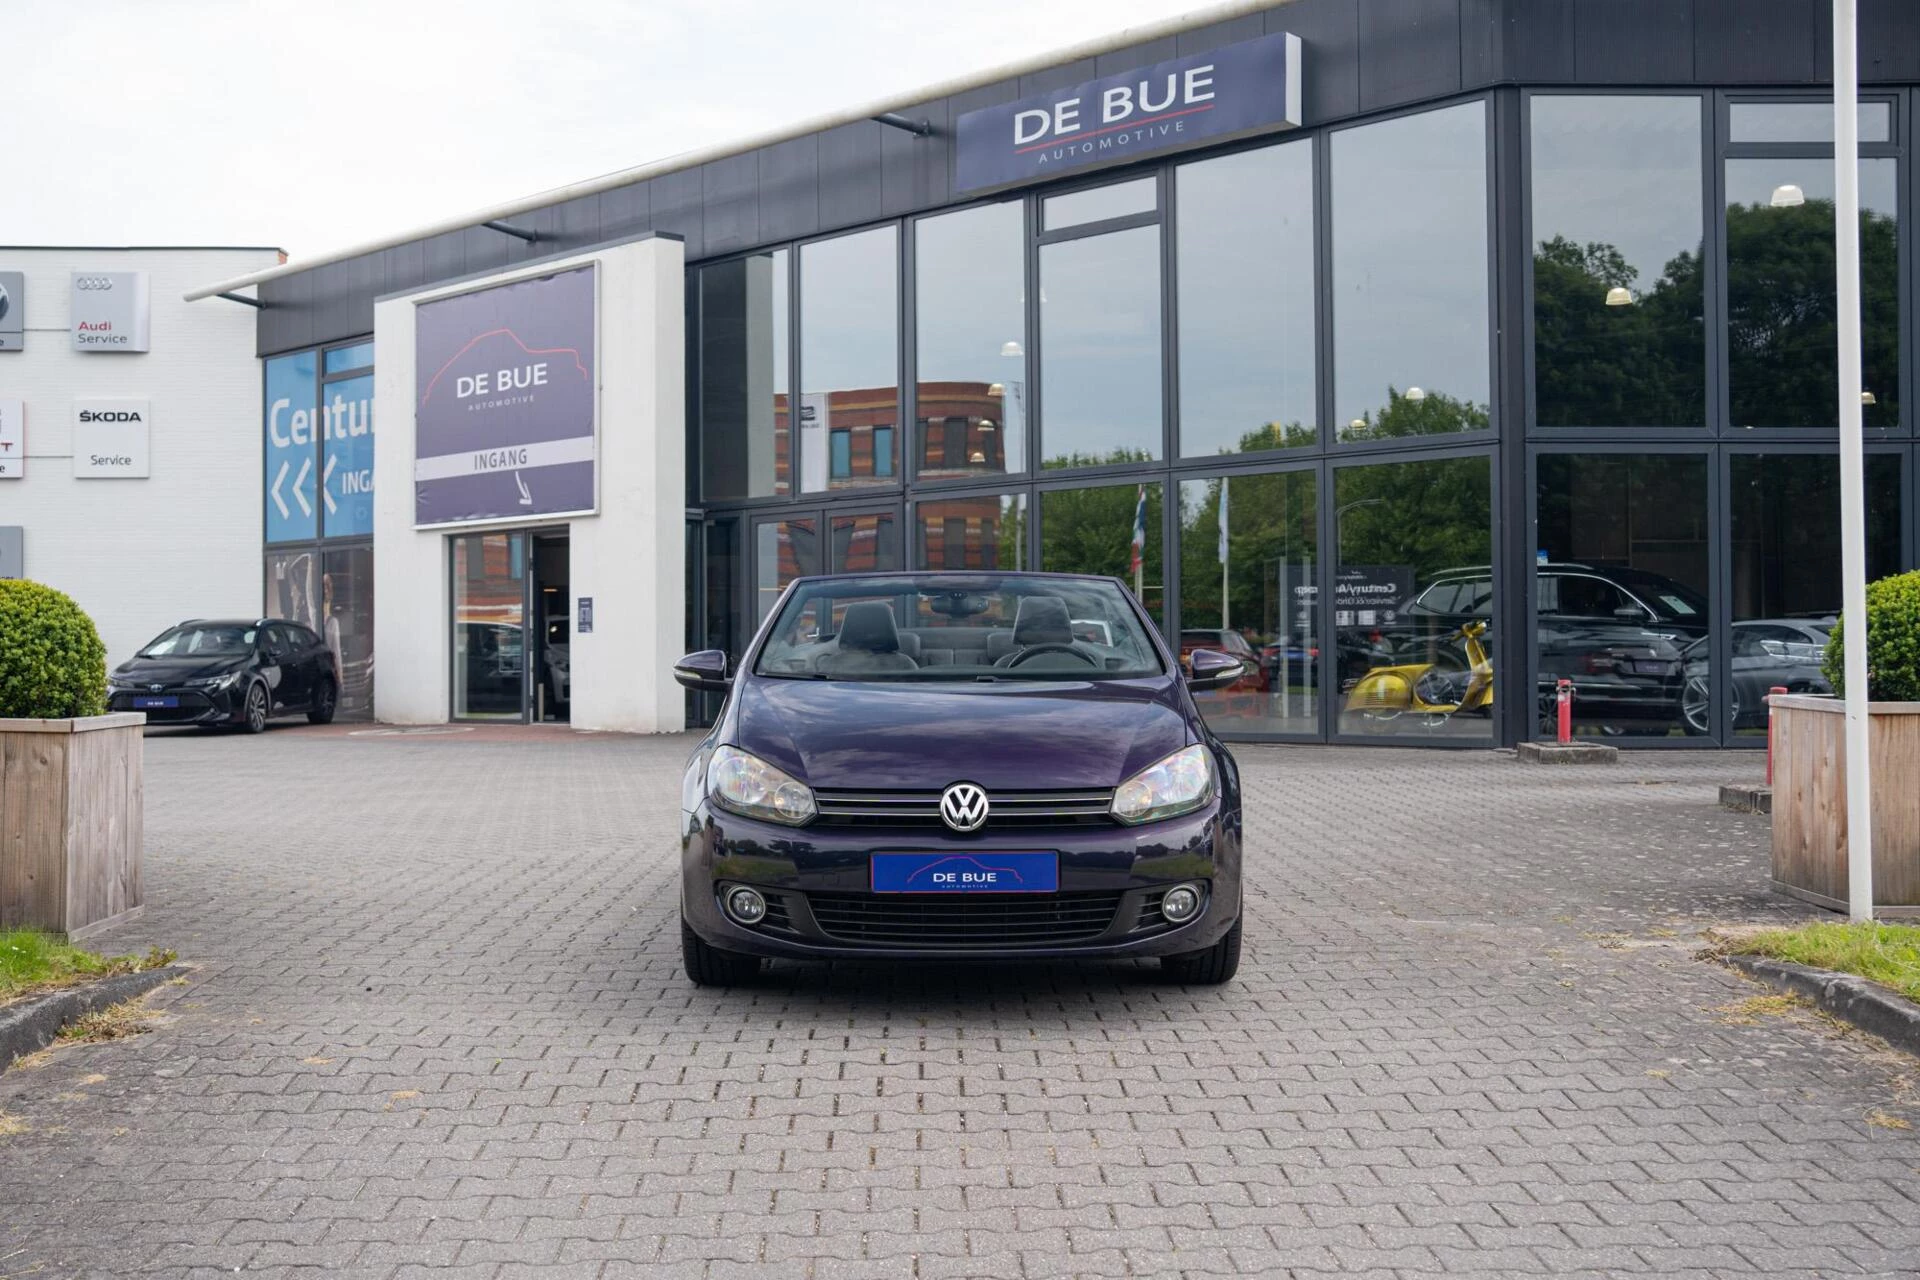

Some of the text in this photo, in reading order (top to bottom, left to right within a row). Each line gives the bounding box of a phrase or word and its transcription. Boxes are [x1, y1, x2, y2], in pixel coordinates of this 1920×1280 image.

[1013, 64, 1215, 145] DE BUE
[1038, 120, 1185, 165] AUTOMOTIVE
[78, 320, 112, 331] Audi
[78, 333, 128, 344] Service
[457, 362, 548, 399] DE BUE
[468, 394, 535, 411] AUTOMOTIVE
[79, 409, 142, 422] ŠKODA
[90, 454, 132, 466] Service
[474, 448, 528, 470] INGANG
[342, 469, 374, 495] ING
[933, 872, 997, 882] DE BUE
